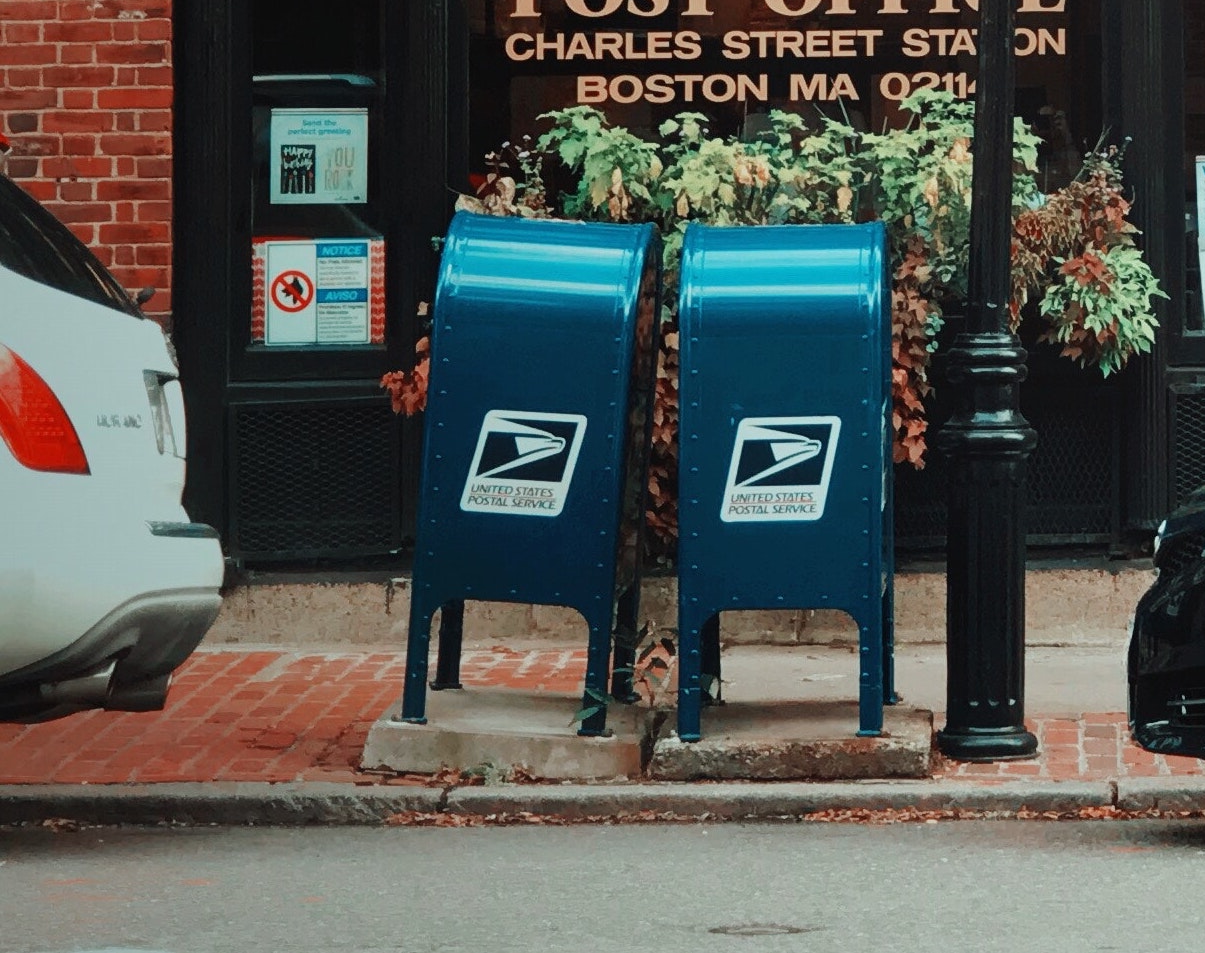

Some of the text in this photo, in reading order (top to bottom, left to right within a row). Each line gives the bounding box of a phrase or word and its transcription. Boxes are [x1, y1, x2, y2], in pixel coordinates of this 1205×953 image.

[505, 27, 1066, 61] CHARLES STREET STAON
[577, 73, 768, 104] BOSTON
[790, 73, 858, 102] MA
[321, 245, 362, 256] NOTICE
[325, 291, 358, 301] AVISO
[471, 485, 554, 497] UNITED STATES
[467, 496, 556, 509] POSTAL SERVICE
[731, 492, 813, 502] UNITED STATES
[728, 504, 816, 514] POSTAL SERVICE
